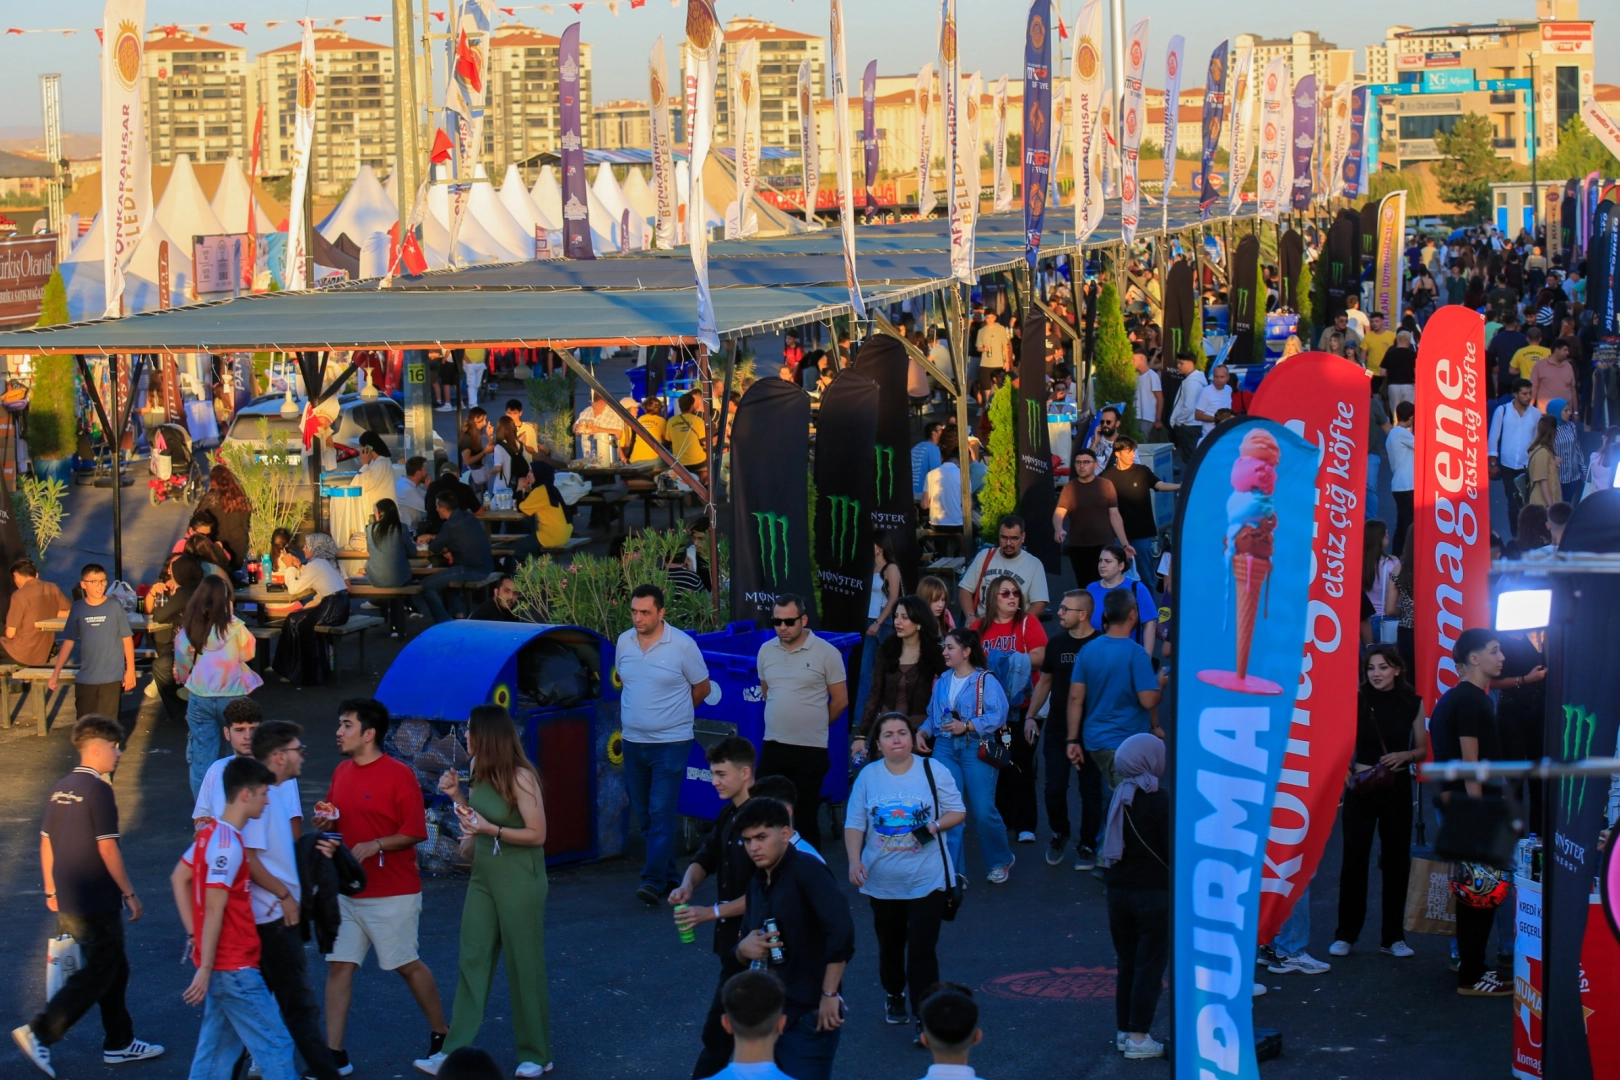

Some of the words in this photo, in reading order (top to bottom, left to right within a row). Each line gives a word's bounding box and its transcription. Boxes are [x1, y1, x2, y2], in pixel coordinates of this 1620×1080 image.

[409, 369, 425, 382] 16
[1464, 341, 1479, 403] köfte
[1327, 401, 1355, 480] köfte
[1463, 404, 1482, 443] çiğ
[1464, 446, 1478, 500] etsiz
[1325, 483, 1356, 527] çiğ
[1323, 530, 1345, 598] etsiz
[1427, 358, 1477, 731] omagene
[817, 569, 863, 591] MONSTER
[824, 583, 857, 596] ENERGY
[1554, 852, 1577, 873] NERGY
[1193, 706, 1270, 1080] DURMA
[1519, 901, 1536, 916] KREDİ
[1516, 979, 1542, 1011] NUMA
